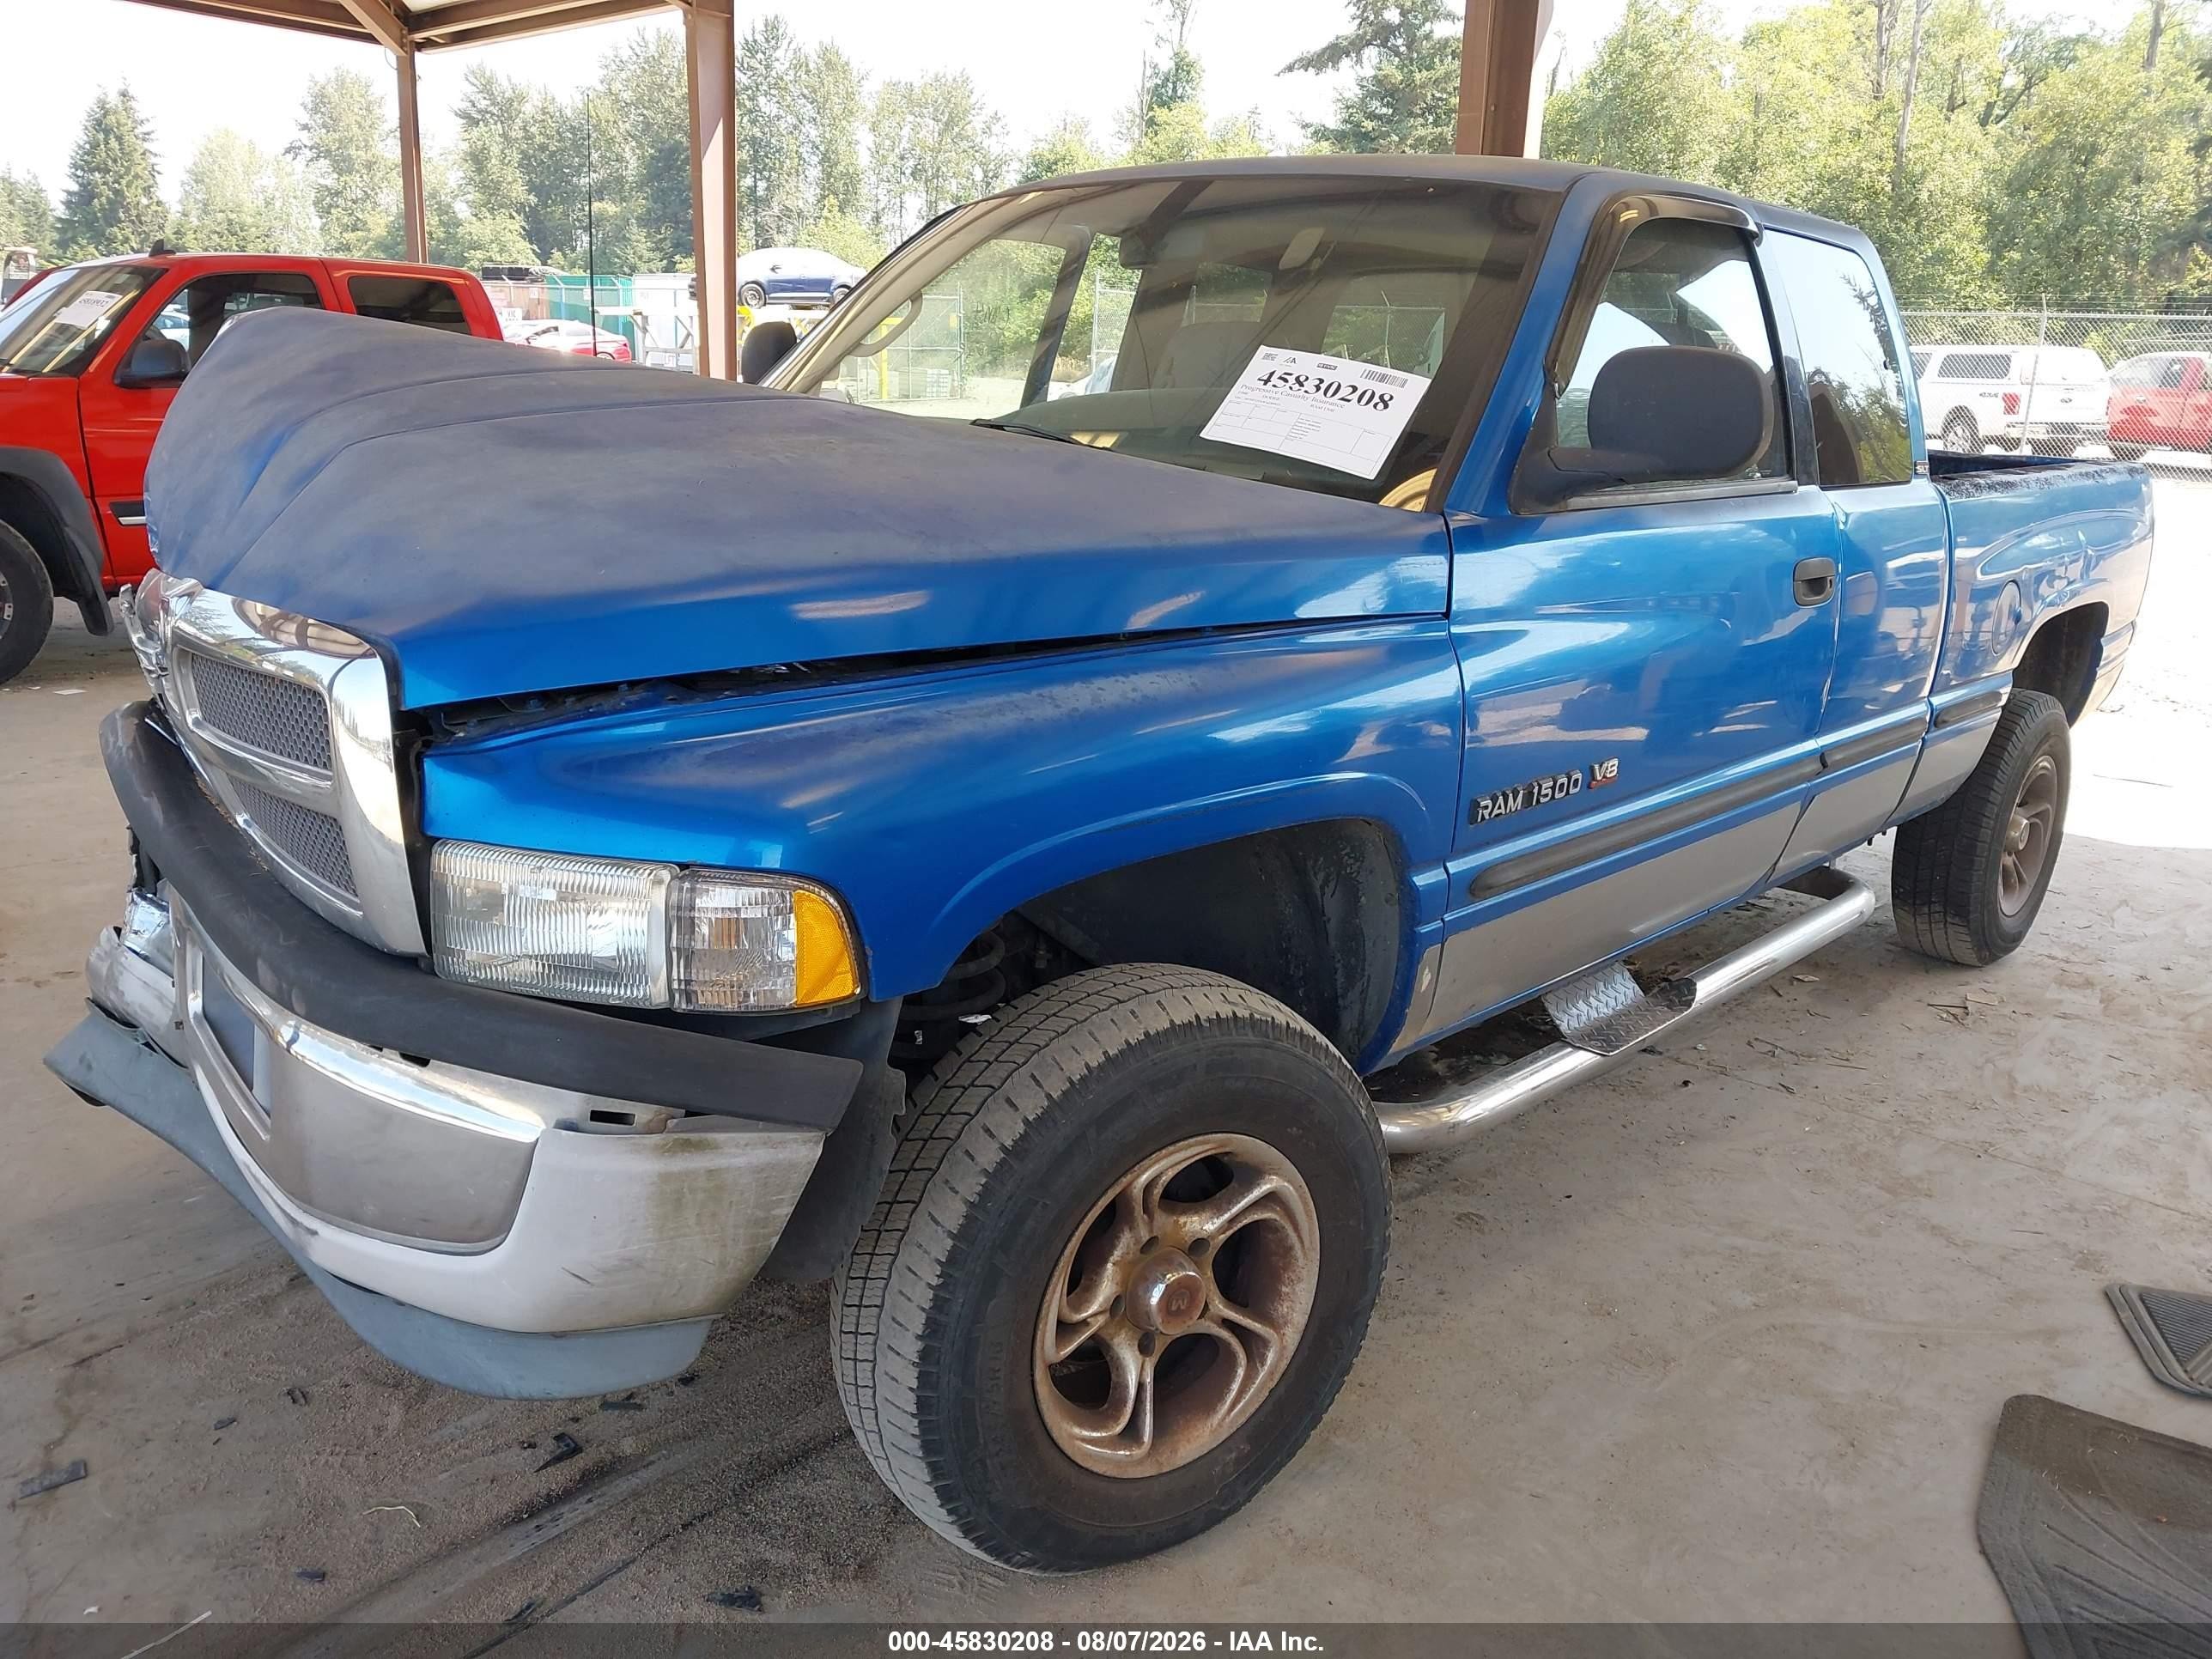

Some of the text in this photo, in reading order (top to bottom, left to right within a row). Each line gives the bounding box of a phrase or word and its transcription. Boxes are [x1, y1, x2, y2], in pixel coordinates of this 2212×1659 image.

[1240, 384, 1279, 396] Progressive
[1280, 390, 1310, 402] Casualty
[1311, 396, 1346, 409] Insurance
[1257, 369, 1395, 412] 45830208
[1592, 757, 1620, 782] V8
[1473, 771, 1583, 823] RAM 1500
